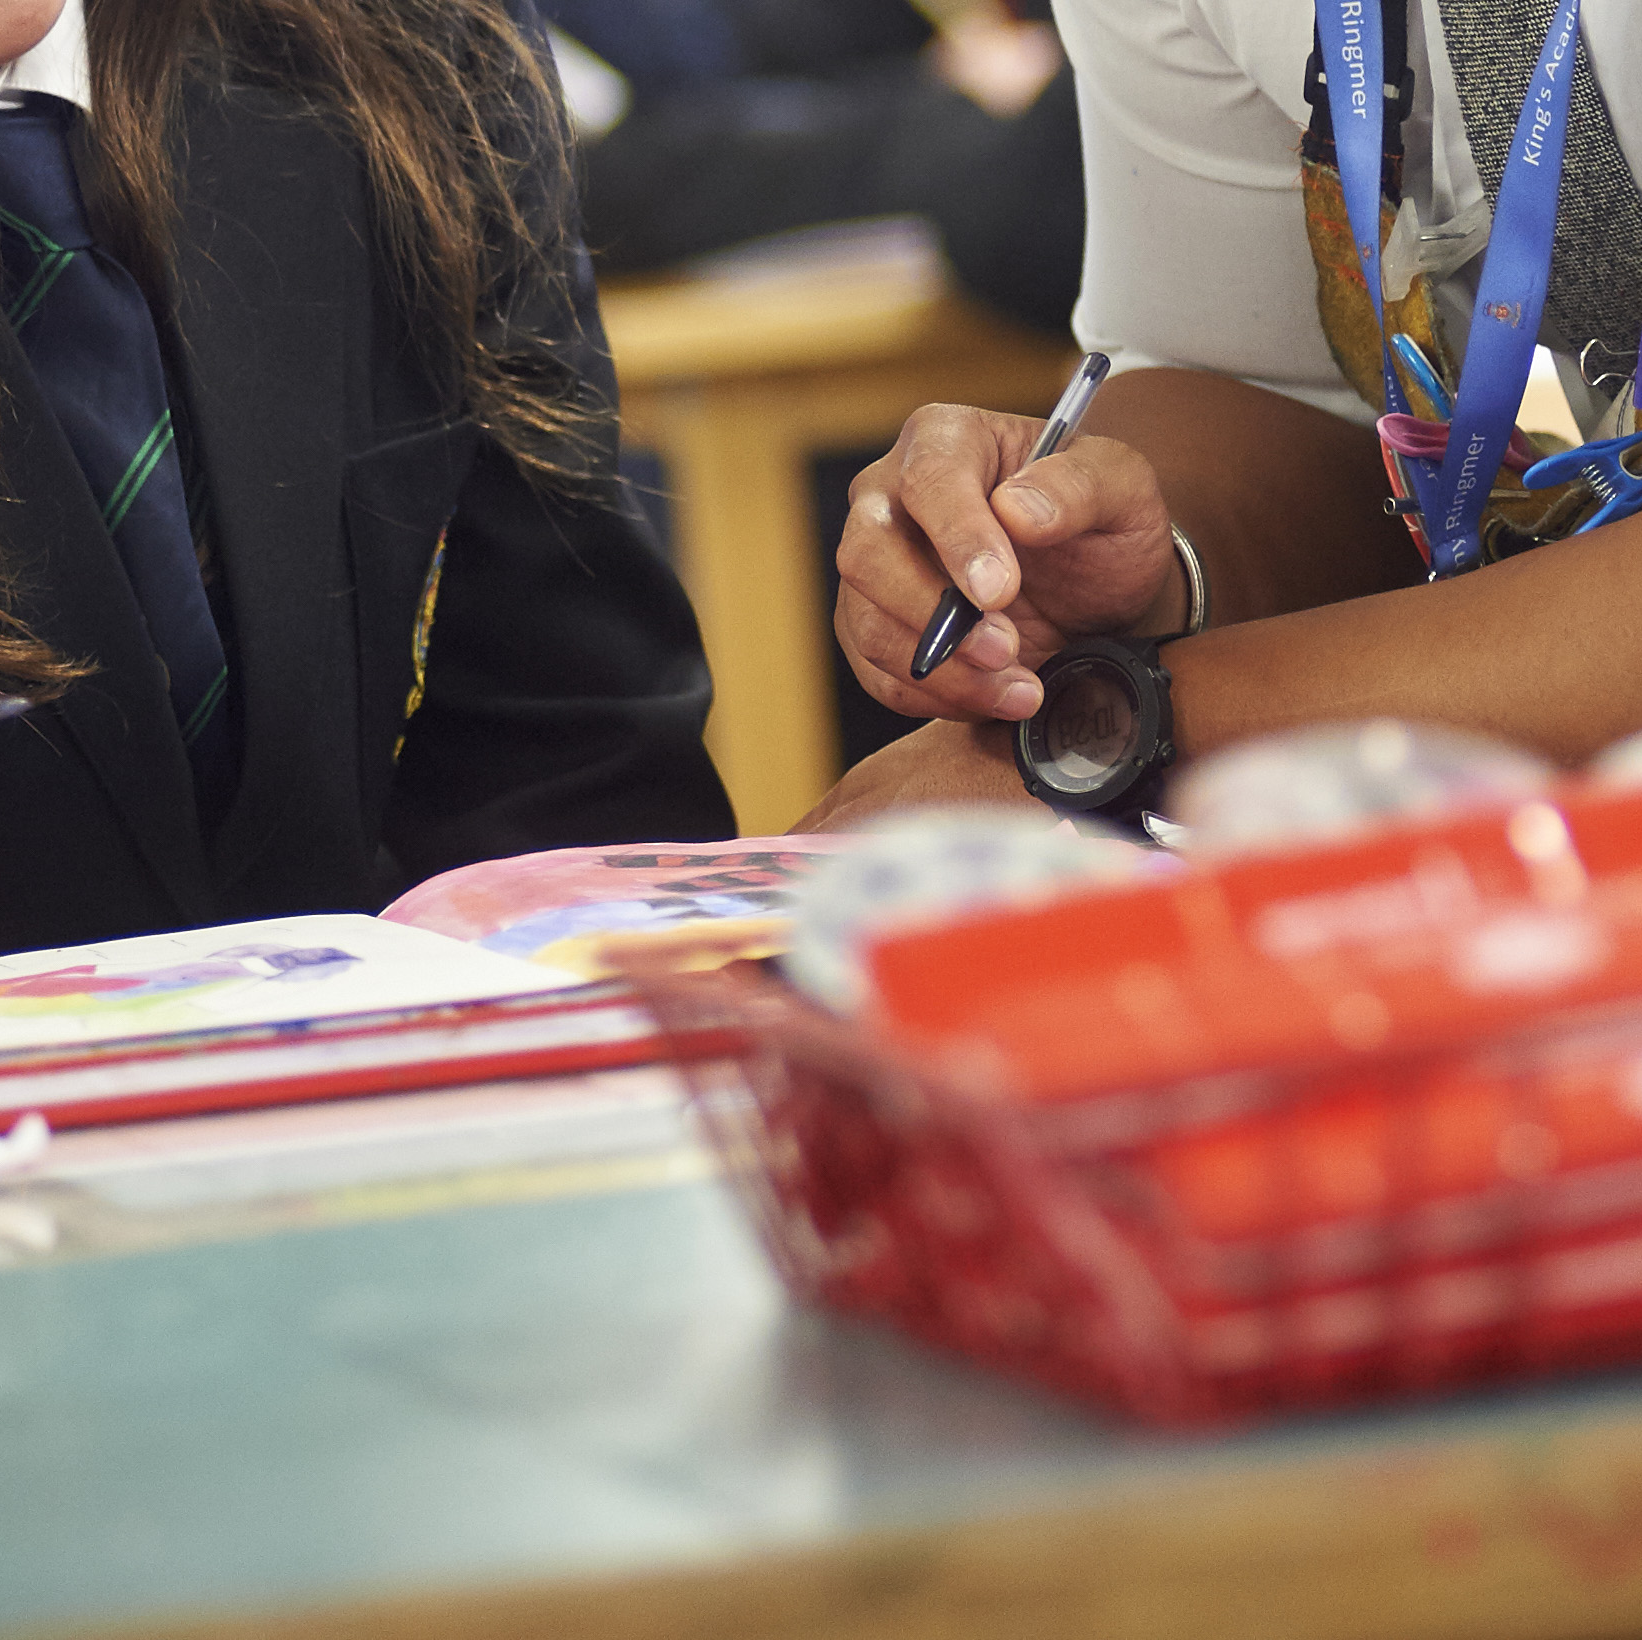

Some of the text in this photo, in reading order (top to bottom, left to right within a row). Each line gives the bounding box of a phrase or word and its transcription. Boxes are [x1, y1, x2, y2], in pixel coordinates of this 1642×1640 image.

[1340, 1, 1367, 120] Ringmer
[1522, 87, 1552, 167] King's
[1446, 433, 1486, 531] Ringmer
